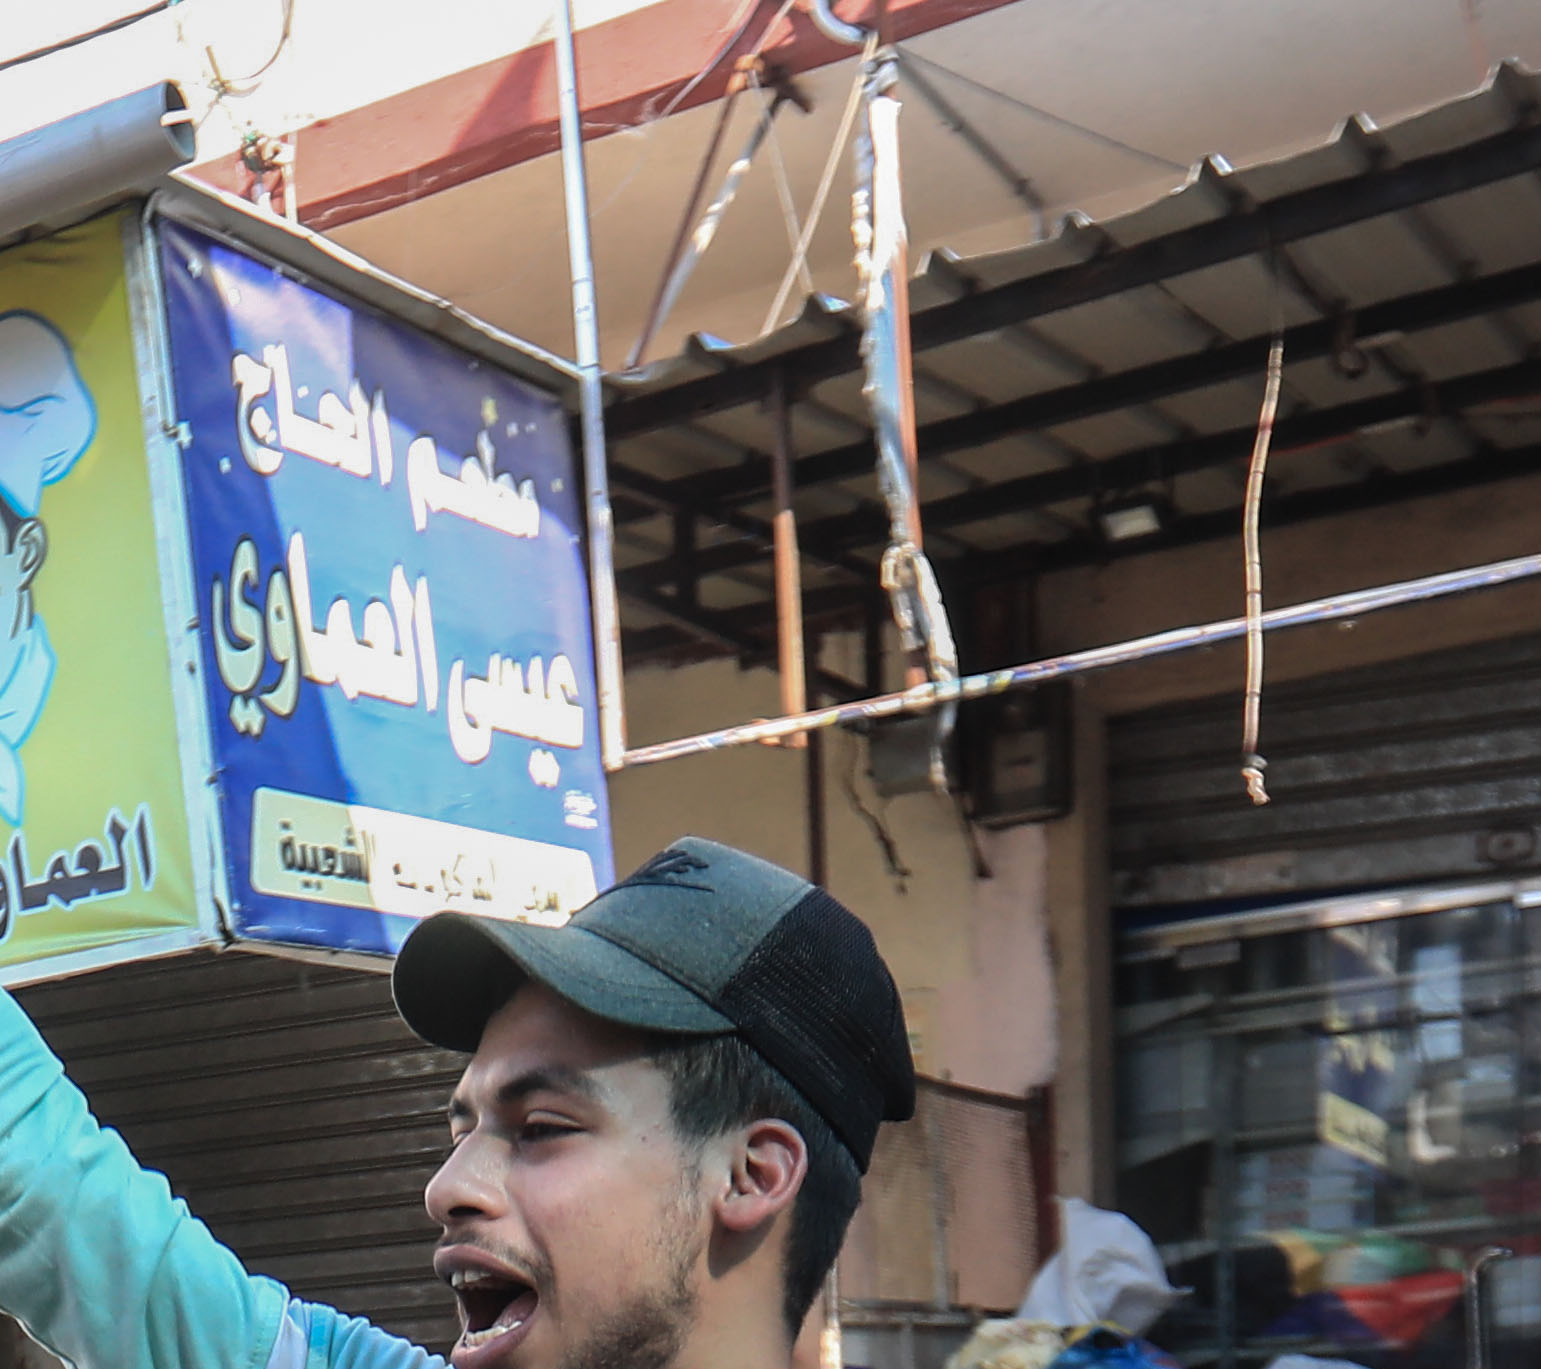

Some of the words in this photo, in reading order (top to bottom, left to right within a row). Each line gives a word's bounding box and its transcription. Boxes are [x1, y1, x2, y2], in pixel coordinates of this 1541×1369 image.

[232, 343, 393, 485] الحاج
[212, 531, 437, 738] العماوي
[447, 652, 584, 788] عيسى
